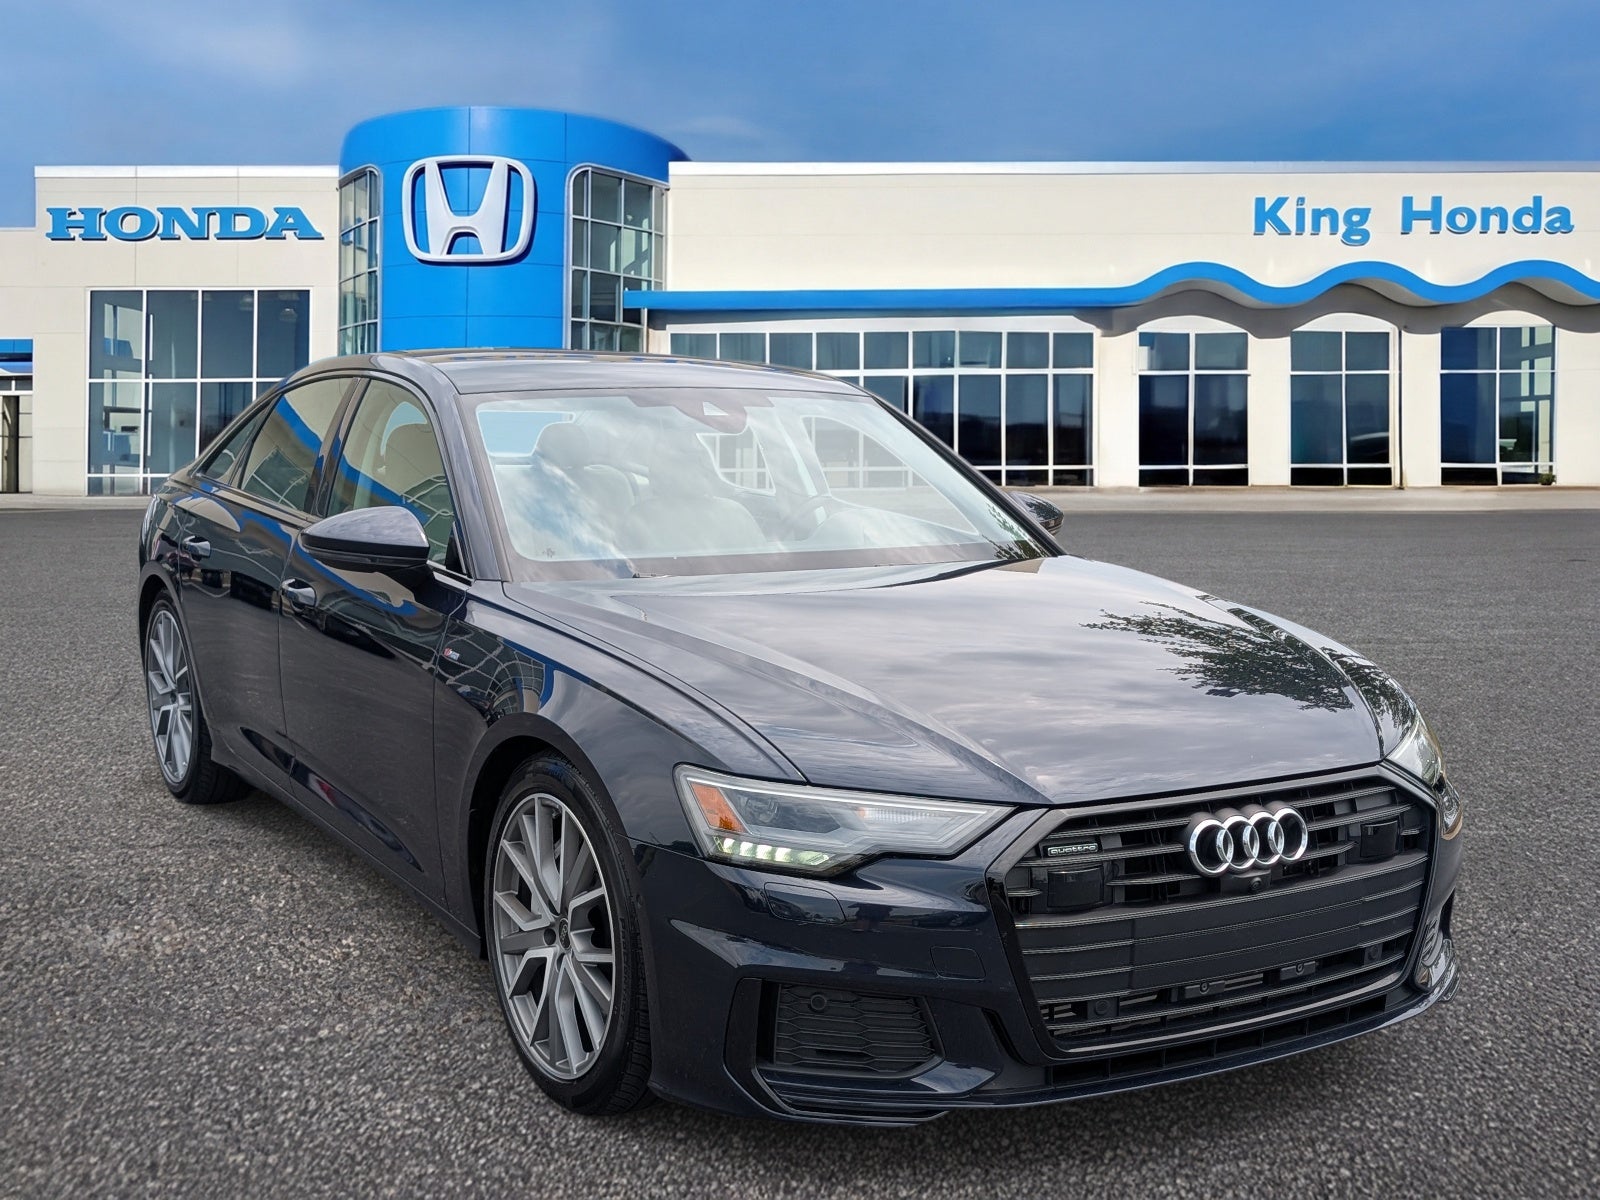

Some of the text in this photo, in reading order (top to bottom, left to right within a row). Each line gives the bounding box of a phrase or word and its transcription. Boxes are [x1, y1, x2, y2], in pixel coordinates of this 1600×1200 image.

[45, 206, 324, 241] HONDA
[1254, 195, 1575, 246] King Honda
[1050, 844, 1097, 855] quattro
